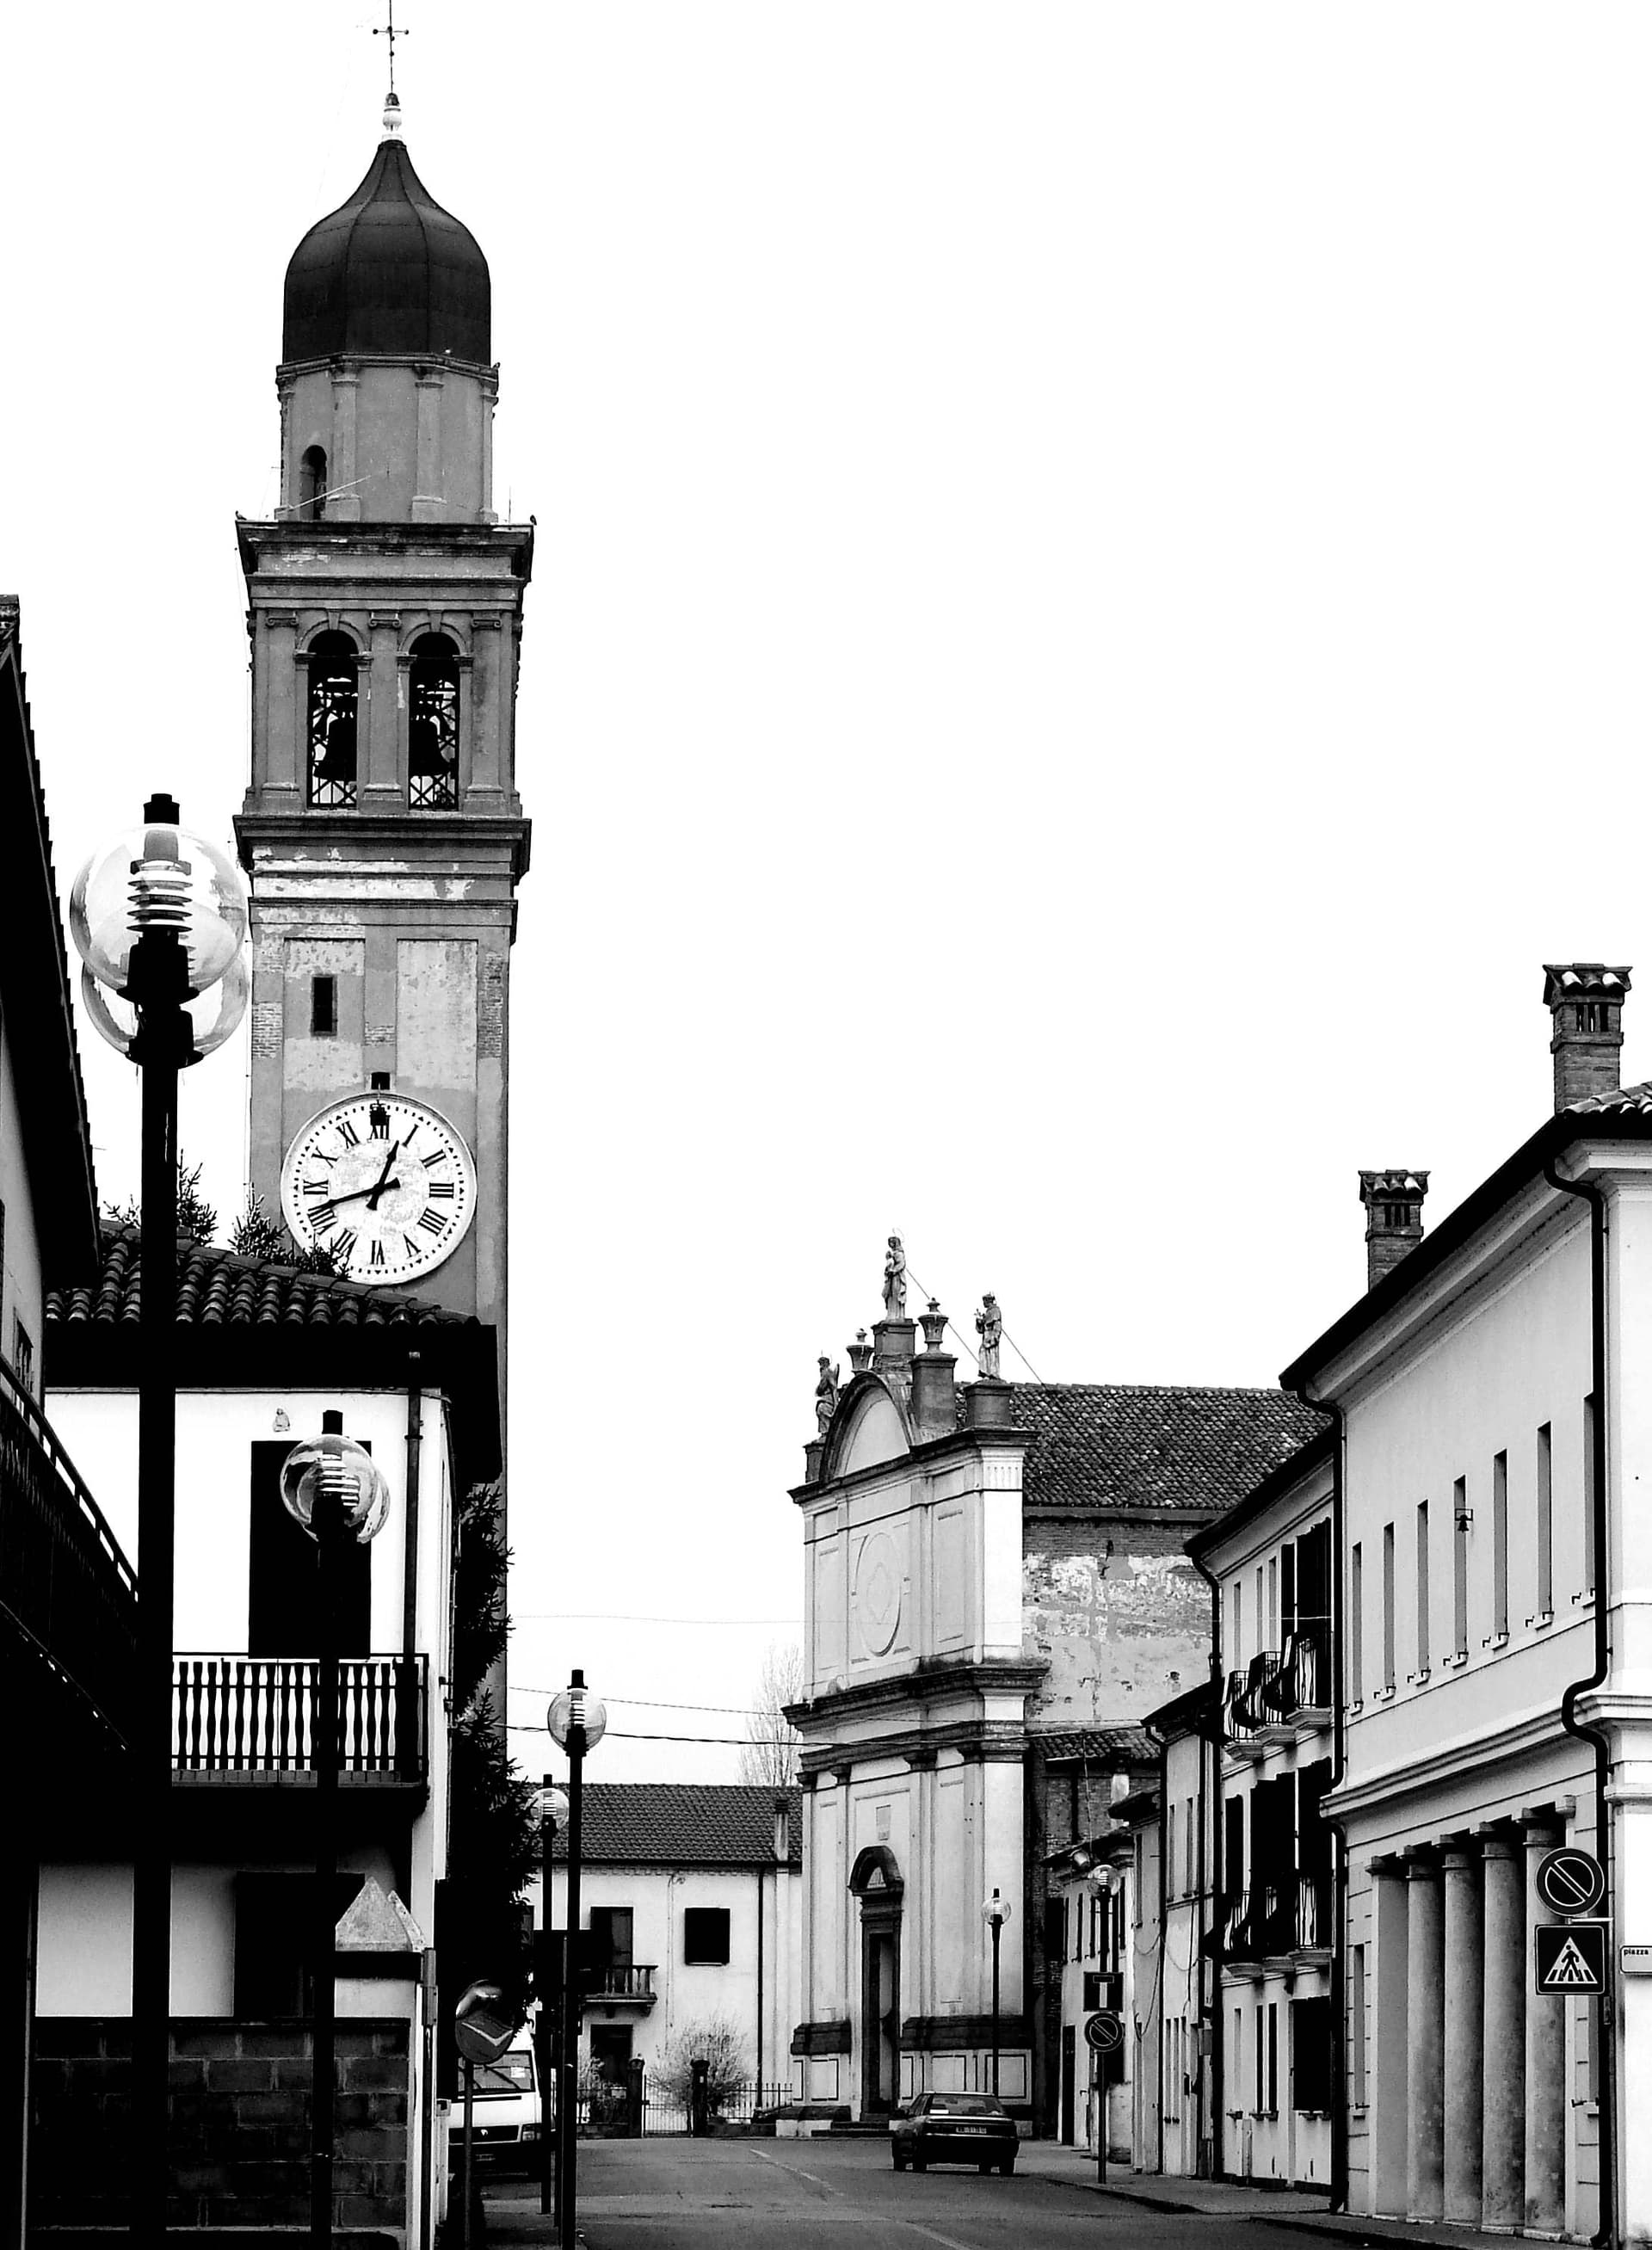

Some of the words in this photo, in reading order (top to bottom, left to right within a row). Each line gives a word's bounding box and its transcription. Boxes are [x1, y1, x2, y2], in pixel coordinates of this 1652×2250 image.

[336, 1120, 361, 1150] XI
[402, 1124, 420, 1148] I
[311, 1146, 338, 1168] X
[420, 1150, 447, 1169] II
[303, 1180, 329, 1196] IX
[429, 1182, 454, 1199] III
[370, 1240, 385, 1266] VI
[404, 1234, 422, 1258] V
